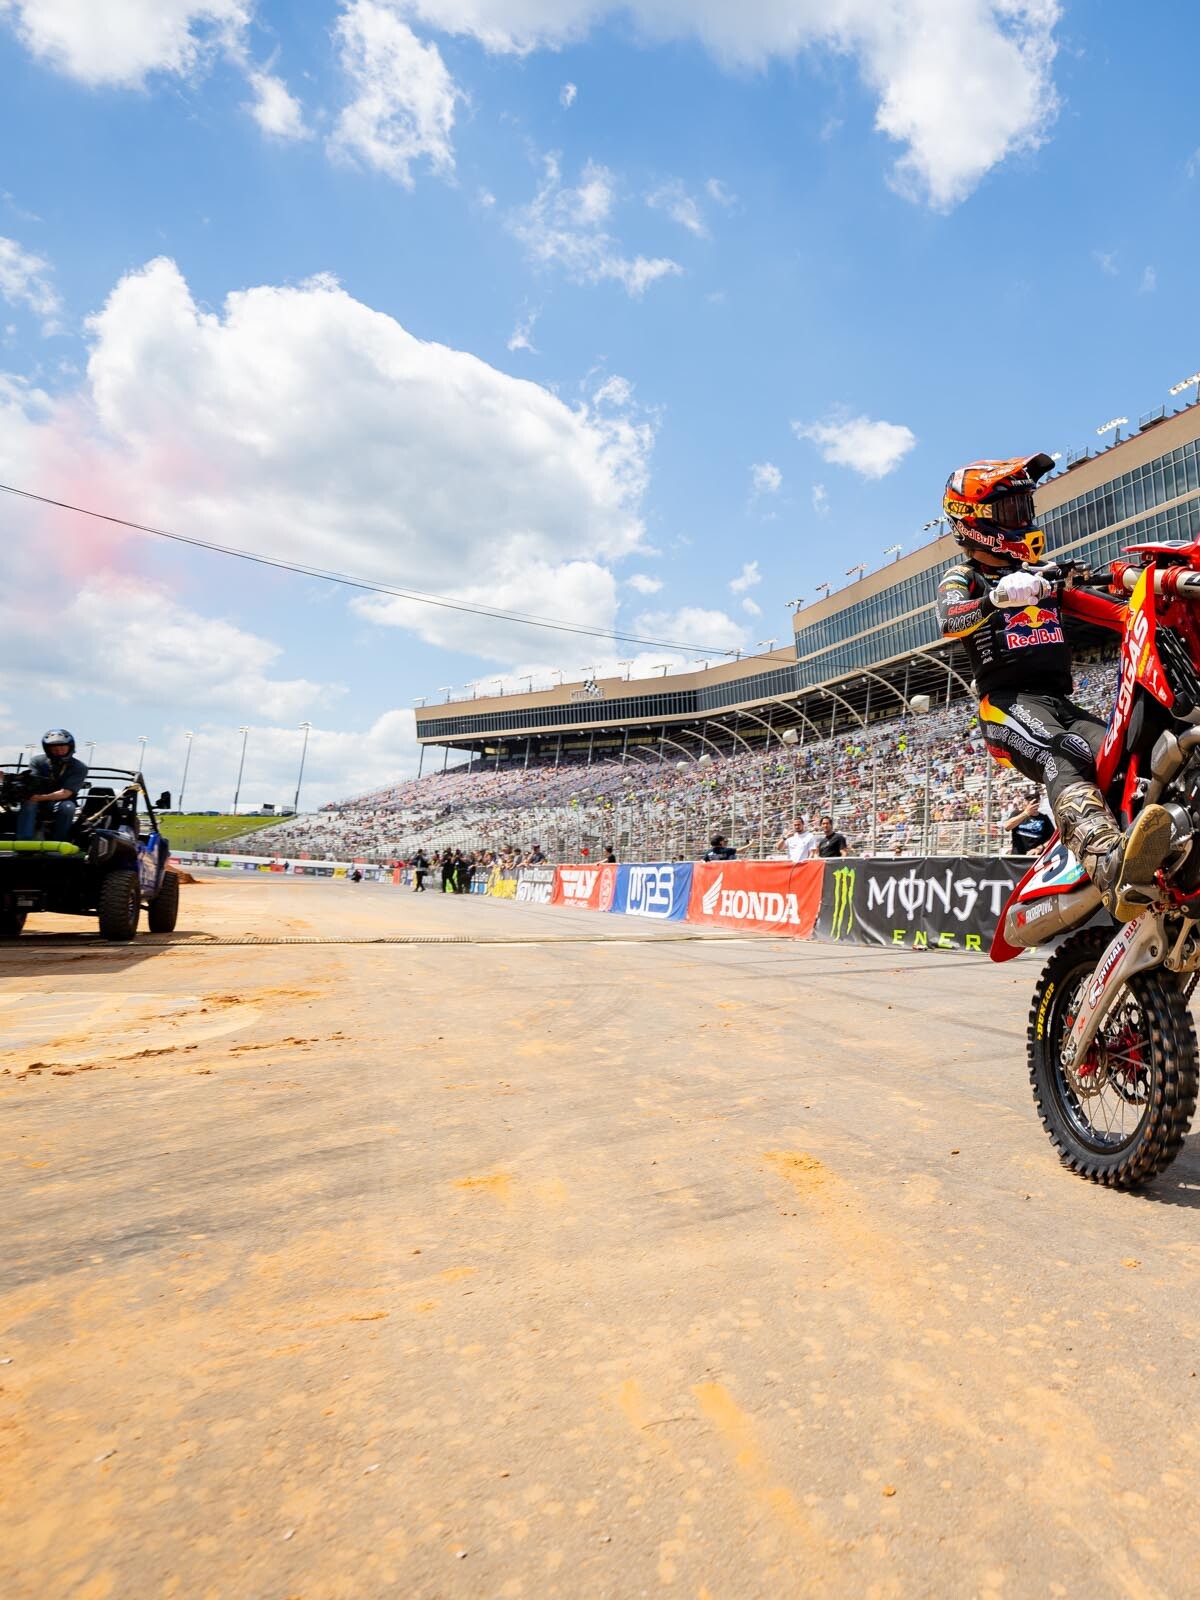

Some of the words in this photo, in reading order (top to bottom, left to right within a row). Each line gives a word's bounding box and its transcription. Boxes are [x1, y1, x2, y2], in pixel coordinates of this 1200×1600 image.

[957, 520, 975, 541] Red
[974, 530, 996, 547] Bull
[1007, 629, 1039, 649] Red
[1038, 628, 1064, 644] Bull
[1104, 609, 1149, 757] GASGAS
[719, 889, 800, 925] HONDA
[867, 868, 1014, 921] MONST
[892, 929, 982, 951] ENER
[1037, 981, 1056, 1036] DUNLOP
